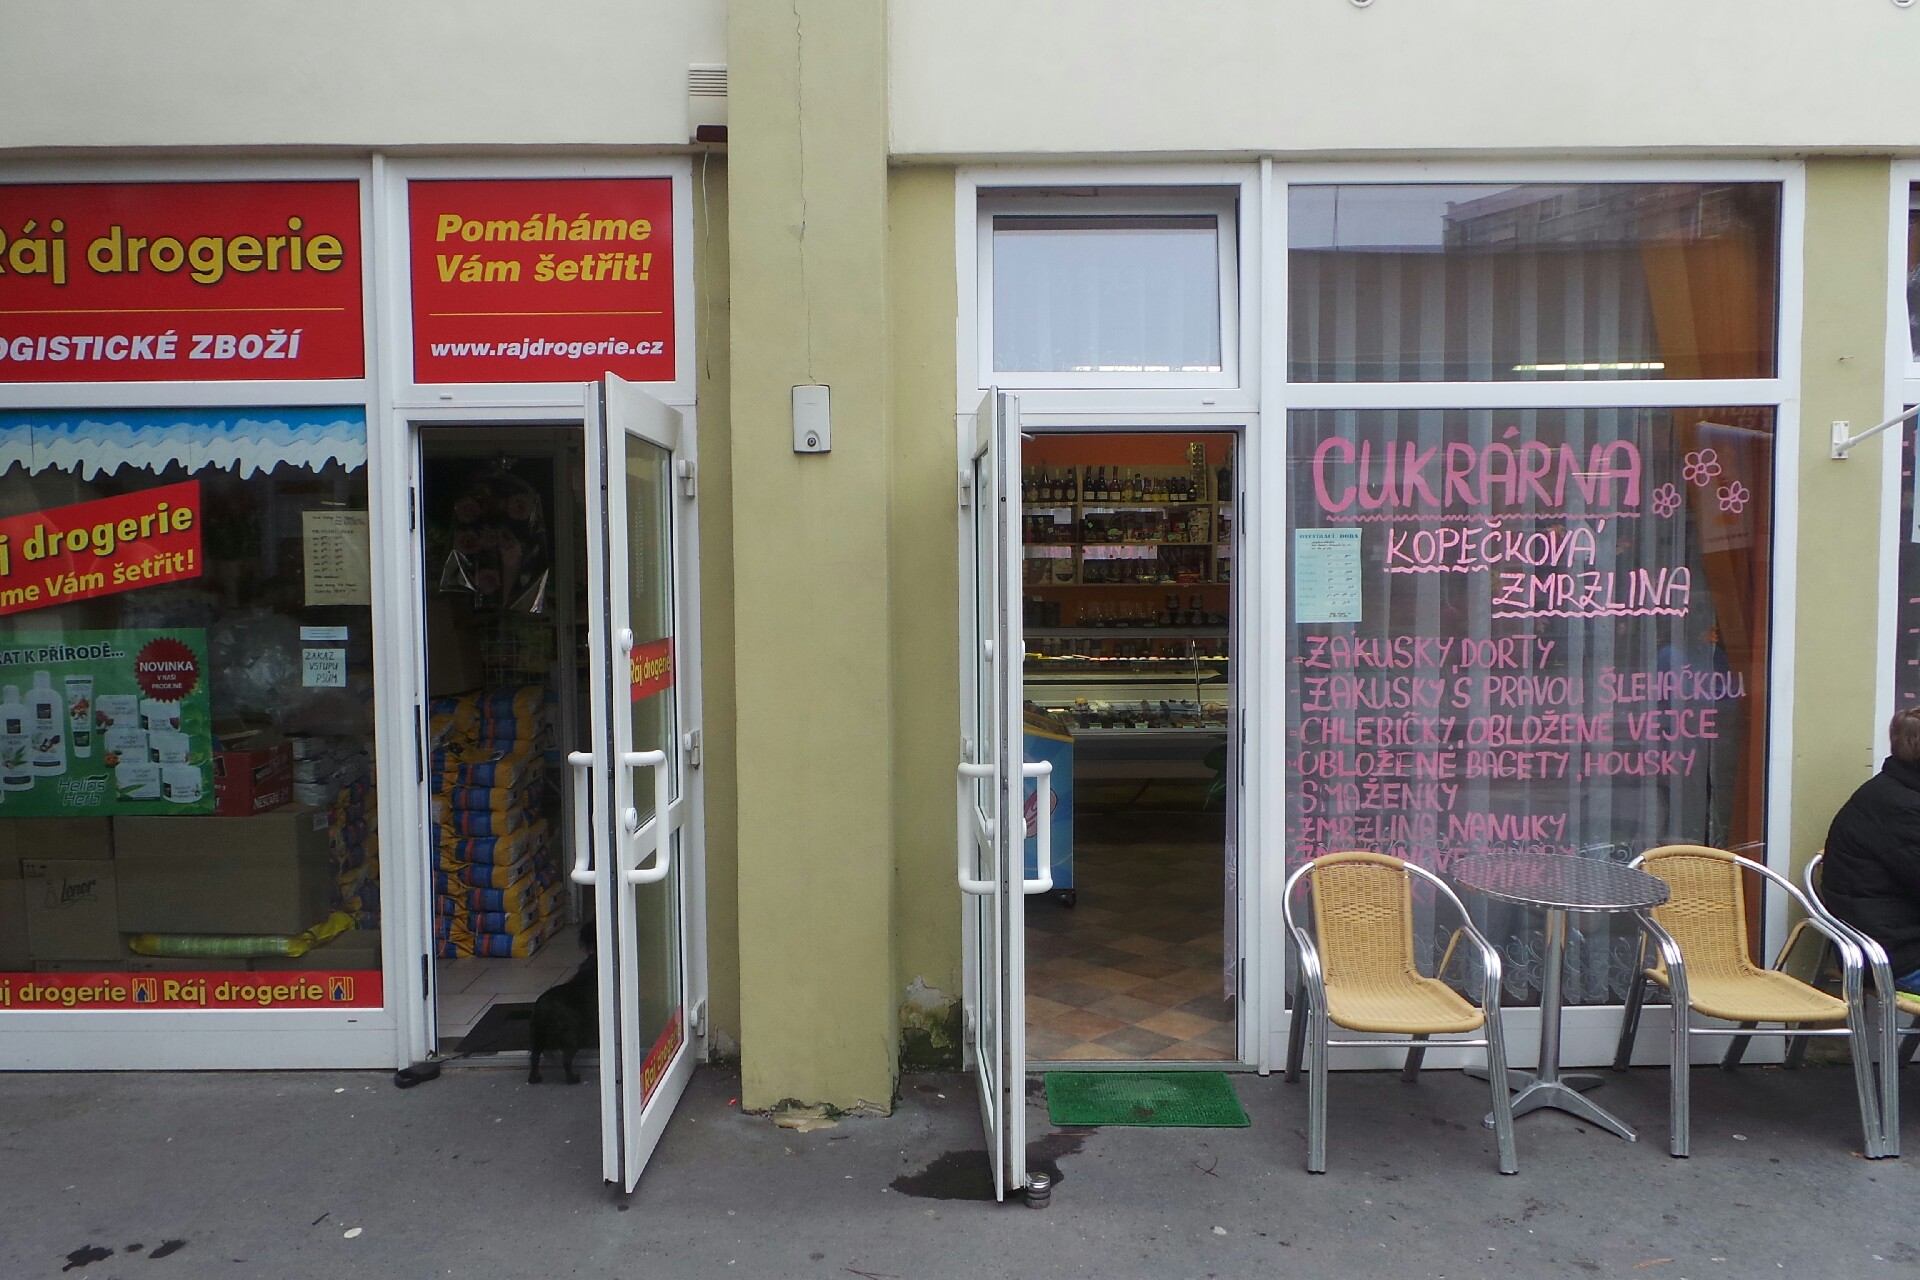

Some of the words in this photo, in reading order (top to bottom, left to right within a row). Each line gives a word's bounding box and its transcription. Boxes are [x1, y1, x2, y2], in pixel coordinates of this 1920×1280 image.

[436, 213, 652, 242] Pomáháme
[0, 218, 66, 285] áj
[87, 216, 344, 284] drogerie
[436, 254, 520, 283] Vám
[534, 252, 653, 281] šetřit!
[189, 329, 303, 359] ZBOŽÍ
[430, 337, 664, 359] www.rajdrogerie.cz
[1313, 426, 1641, 513] CUKRÁRNA
[23, 502, 194, 561] drogerie
[1387, 519, 1605, 568] KOPEČKOVÁ
[45, 571, 105, 597] Vám
[113, 549, 194, 585] šetřit!
[1492, 566, 1691, 611] ZMRZLINA
[24, 650, 34, 663] K
[140, 661, 193, 671] NOVINKA
[310, 662, 338, 670] VSTUPU
[643, 649, 671, 680] drogerie
[1452, 675, 1474, 709] S
[1483, 673, 1585, 708] PRAVOU
[1600, 665, 1747, 704] ŠLEHAČKOU
[1627, 708, 1720, 742] VEJCE
[1298, 745, 1457, 780] OBLOŽENÉ
[58, 776, 106, 793] Helios
[62, 791, 101, 807] Herb
[1449, 811, 1567, 846] NANUKY
[60, 876, 96, 903] Lenor
[19, 979, 127, 1007] drogerie
[164, 979, 207, 1005] Ráj
[214, 978, 324, 1006] drogerie
